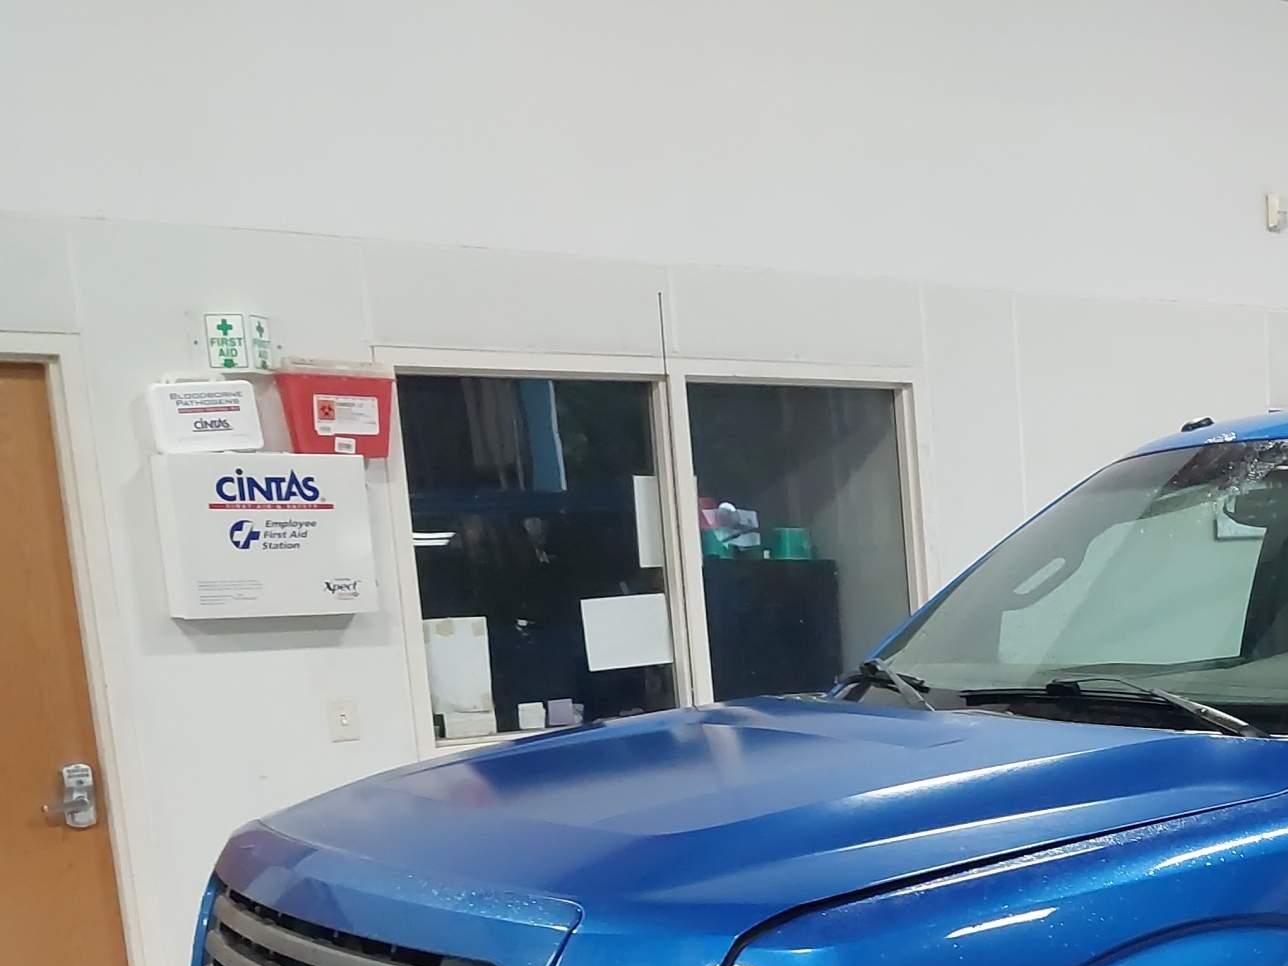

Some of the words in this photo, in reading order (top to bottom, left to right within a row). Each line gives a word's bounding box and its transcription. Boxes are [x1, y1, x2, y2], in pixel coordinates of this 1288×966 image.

[210, 337, 243, 347] FIRST
[218, 348, 238, 358] AID
[169, 391, 243, 400] BLOODBORNE
[176, 398, 240, 407] PATHOGENS
[215, 467, 320, 502] CINTAS
[265, 518, 317, 529] Employee
[263, 530, 287, 539] First
[289, 530, 308, 539] Aid
[262, 541, 301, 551] Station
